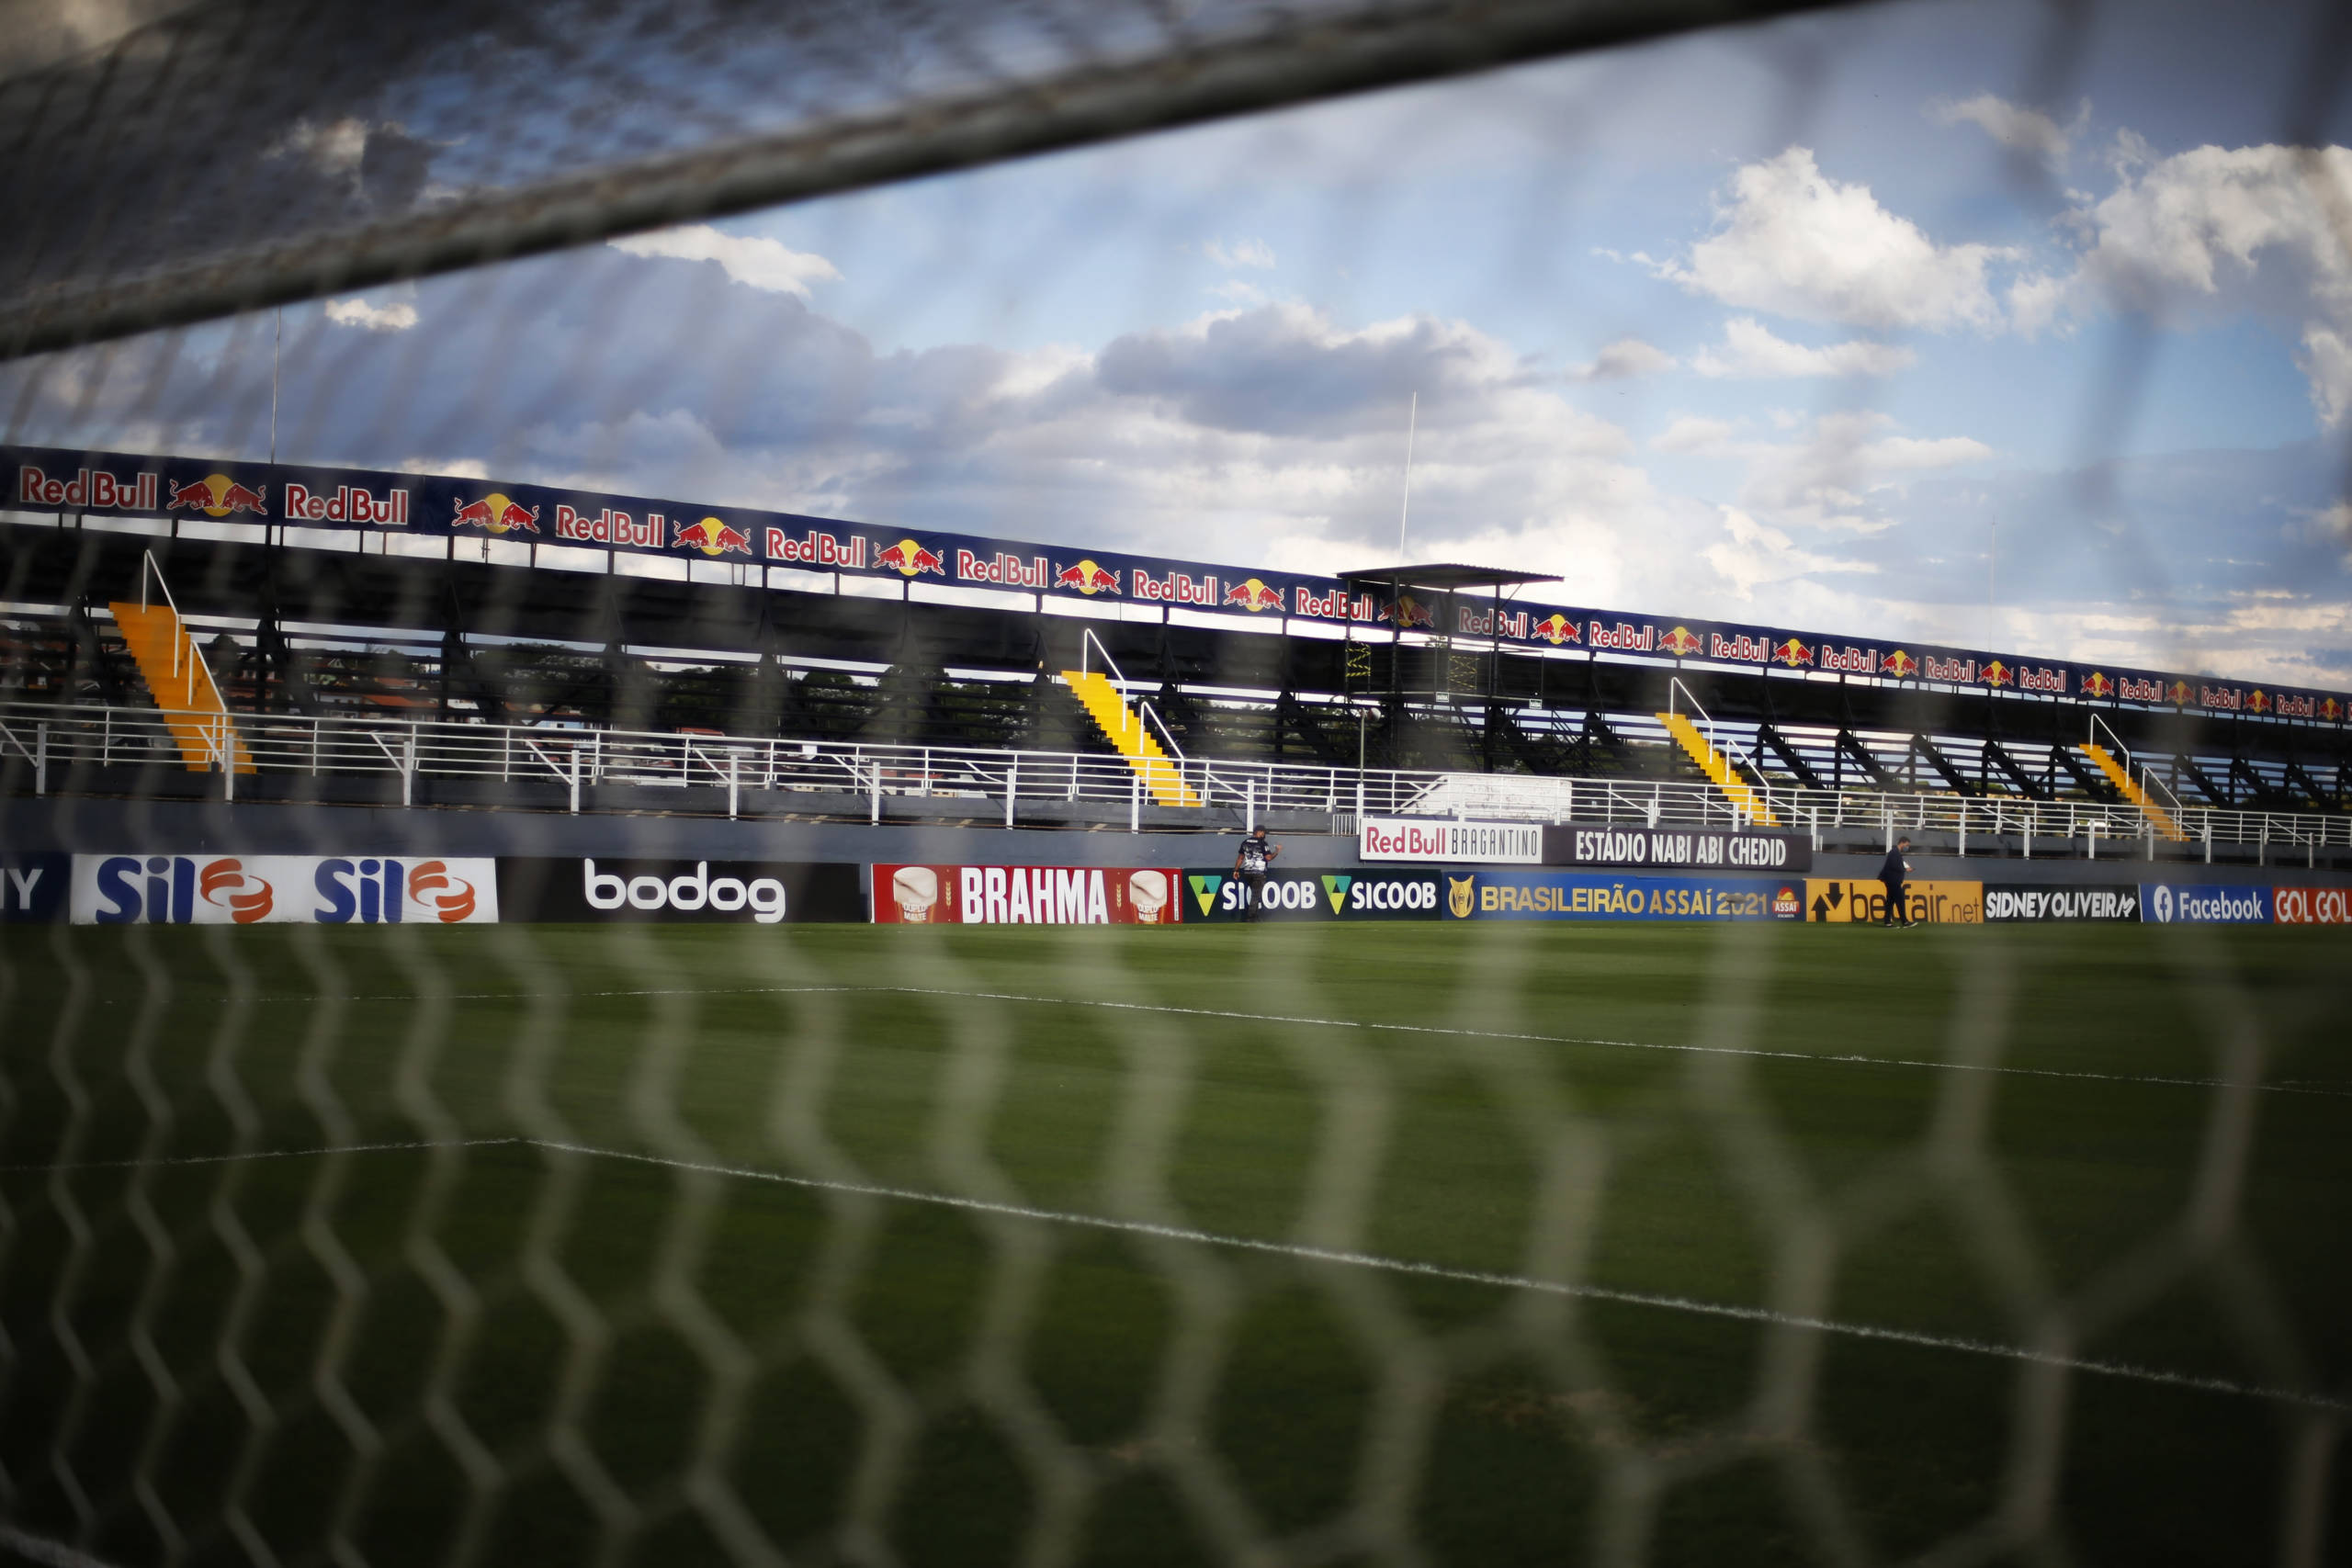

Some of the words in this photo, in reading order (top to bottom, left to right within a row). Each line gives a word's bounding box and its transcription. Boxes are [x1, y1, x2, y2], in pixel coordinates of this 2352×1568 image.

[1366, 826, 1406, 853] Red
[1409, 828, 1445, 855] Bull
[1452, 828, 1537, 856] BRAGANTINO
[1576, 828, 1645, 863] ESTÁDIO
[1652, 834, 1691, 864] NABI
[1696, 836, 1724, 864] ABI
[1729, 837, 1786, 866] CHEDID
[584, 858, 786, 923] bodog
[961, 867, 1108, 923] BRAHMA
[1352, 881, 1436, 909] SICOOB
[1481, 884, 1645, 912] BRASILEIRÃO
[1985, 892, 2051, 918] SIDNEY
[2179, 891, 2264, 919] Facebook
[2276, 890, 2312, 922] GOL
[2316, 891, 2352, 922] GOL
